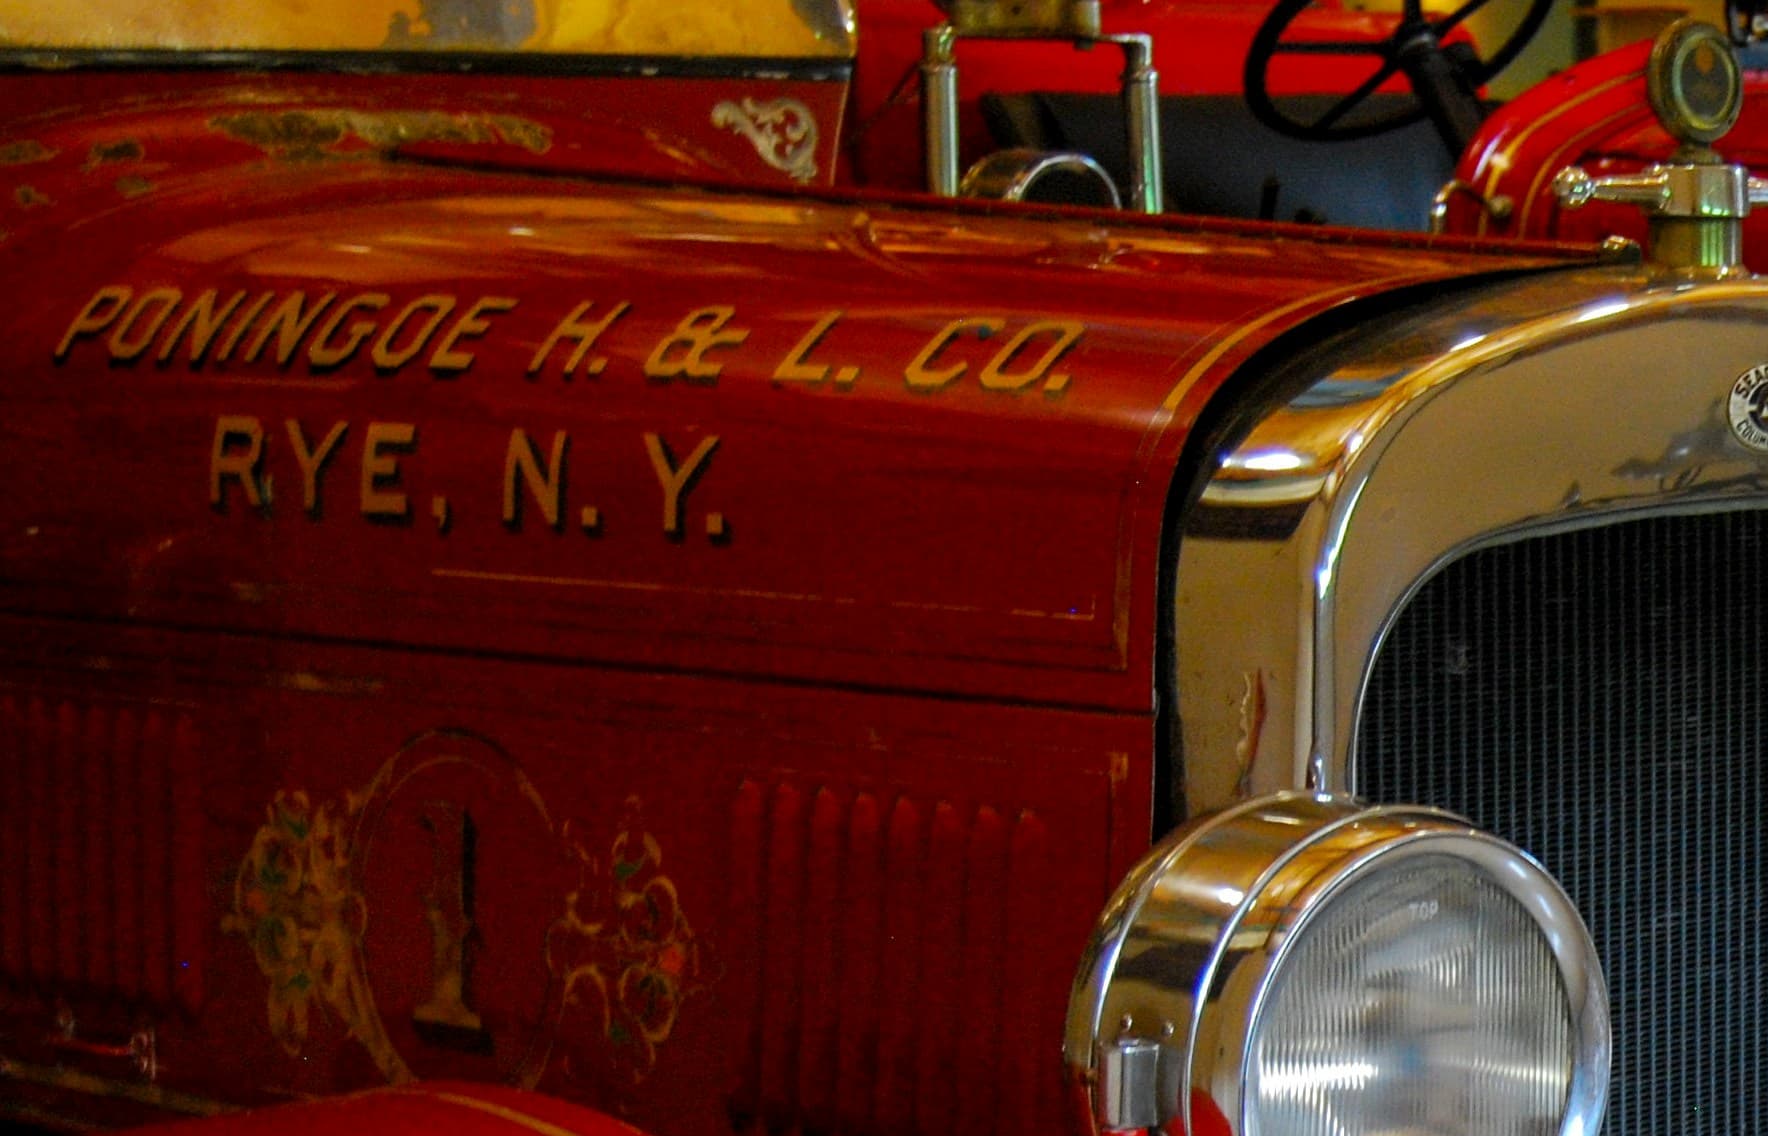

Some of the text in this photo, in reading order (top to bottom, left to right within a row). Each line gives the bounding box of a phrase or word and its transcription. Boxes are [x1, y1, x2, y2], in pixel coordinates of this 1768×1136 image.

[53, 285, 1086, 393] PONINGOE H. & L. CO.
[209, 414, 731, 546] RYE, N. Y.
[1407, 900, 1439, 922] TOP
